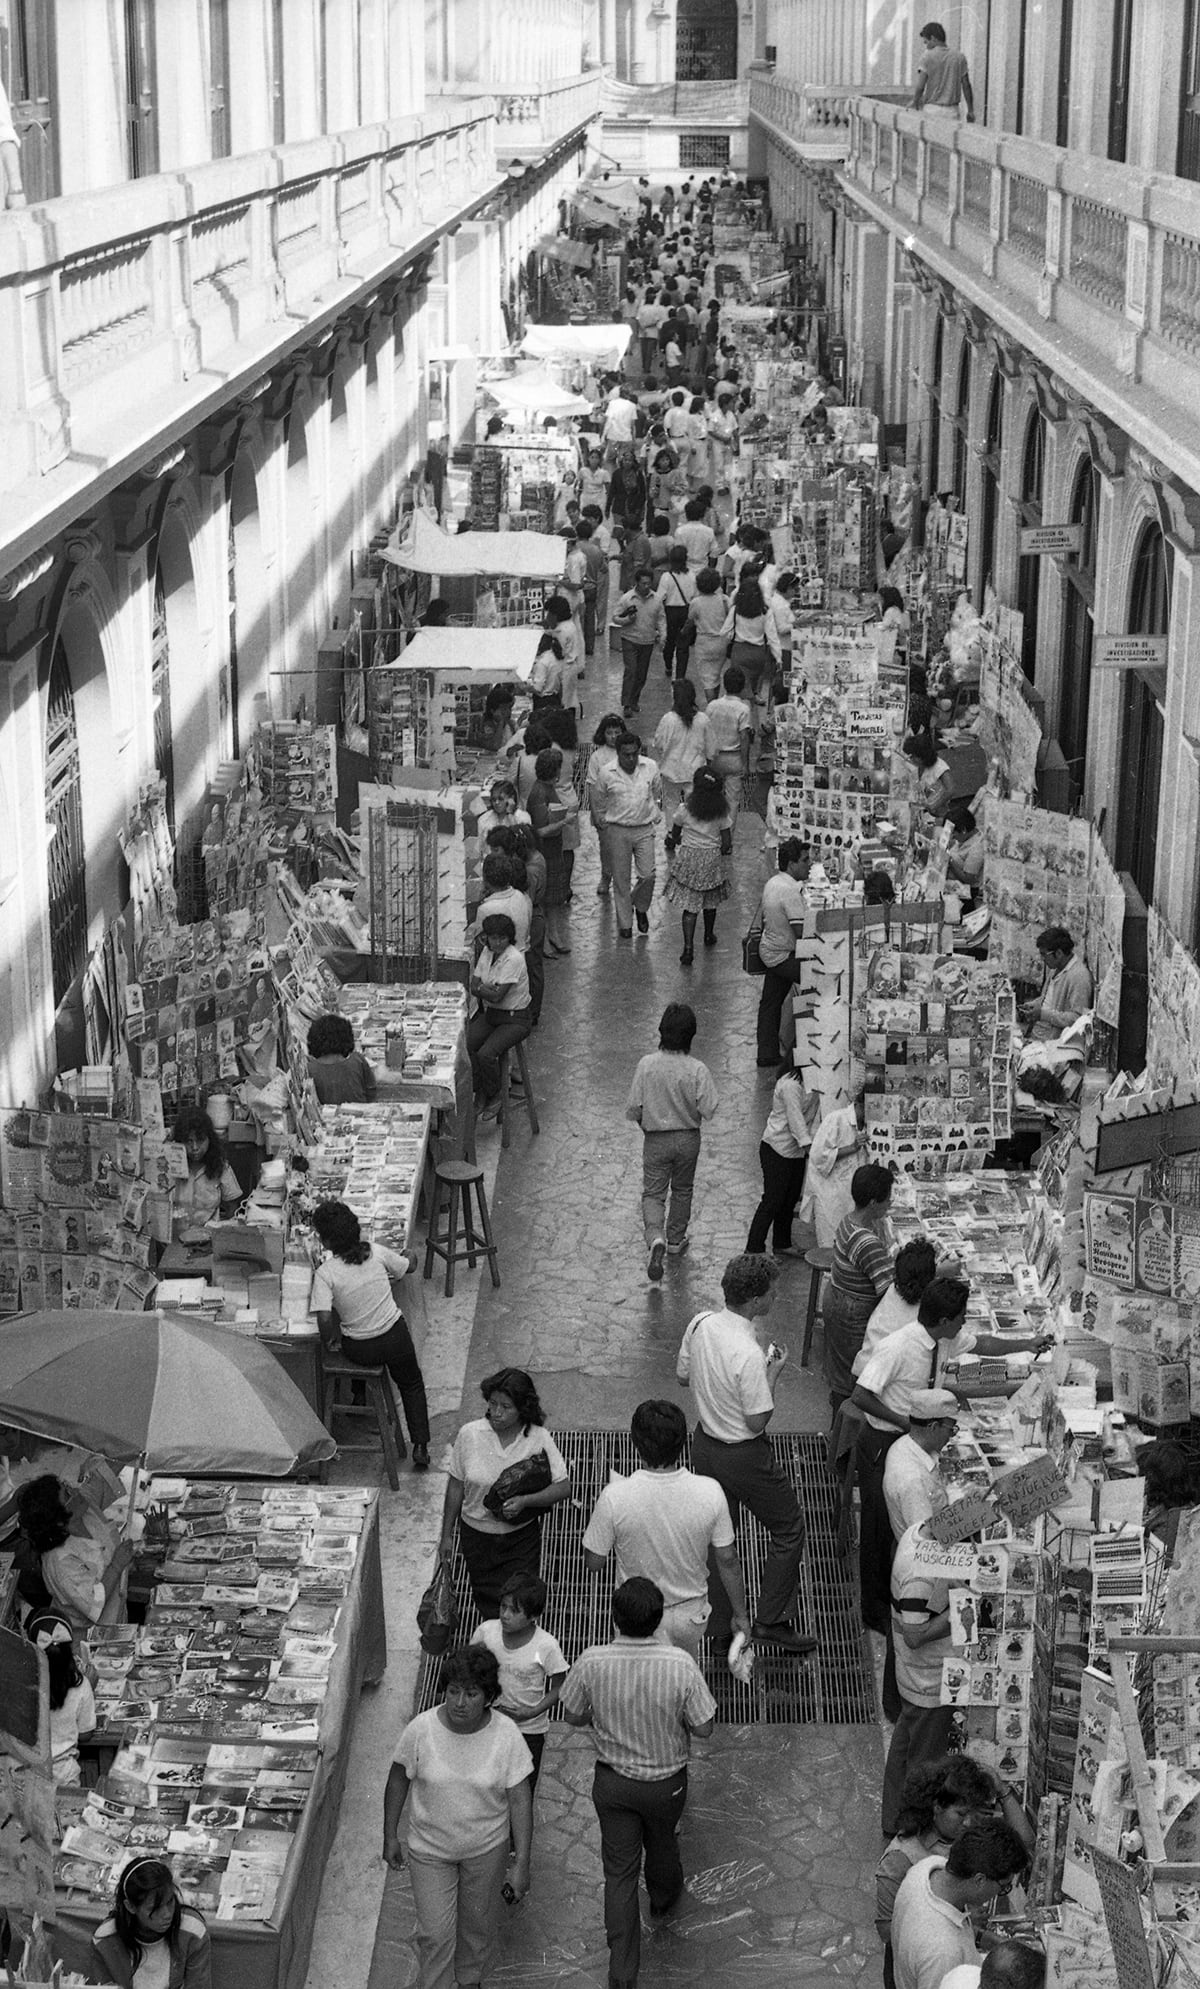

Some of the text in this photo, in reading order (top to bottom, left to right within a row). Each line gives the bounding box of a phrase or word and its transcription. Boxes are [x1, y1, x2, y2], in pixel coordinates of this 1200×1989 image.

[925, 1491, 980, 1528] TARJETAS
[941, 1512, 987, 1544] UNICEF
[914, 1552, 973, 1567] MUSICALES
